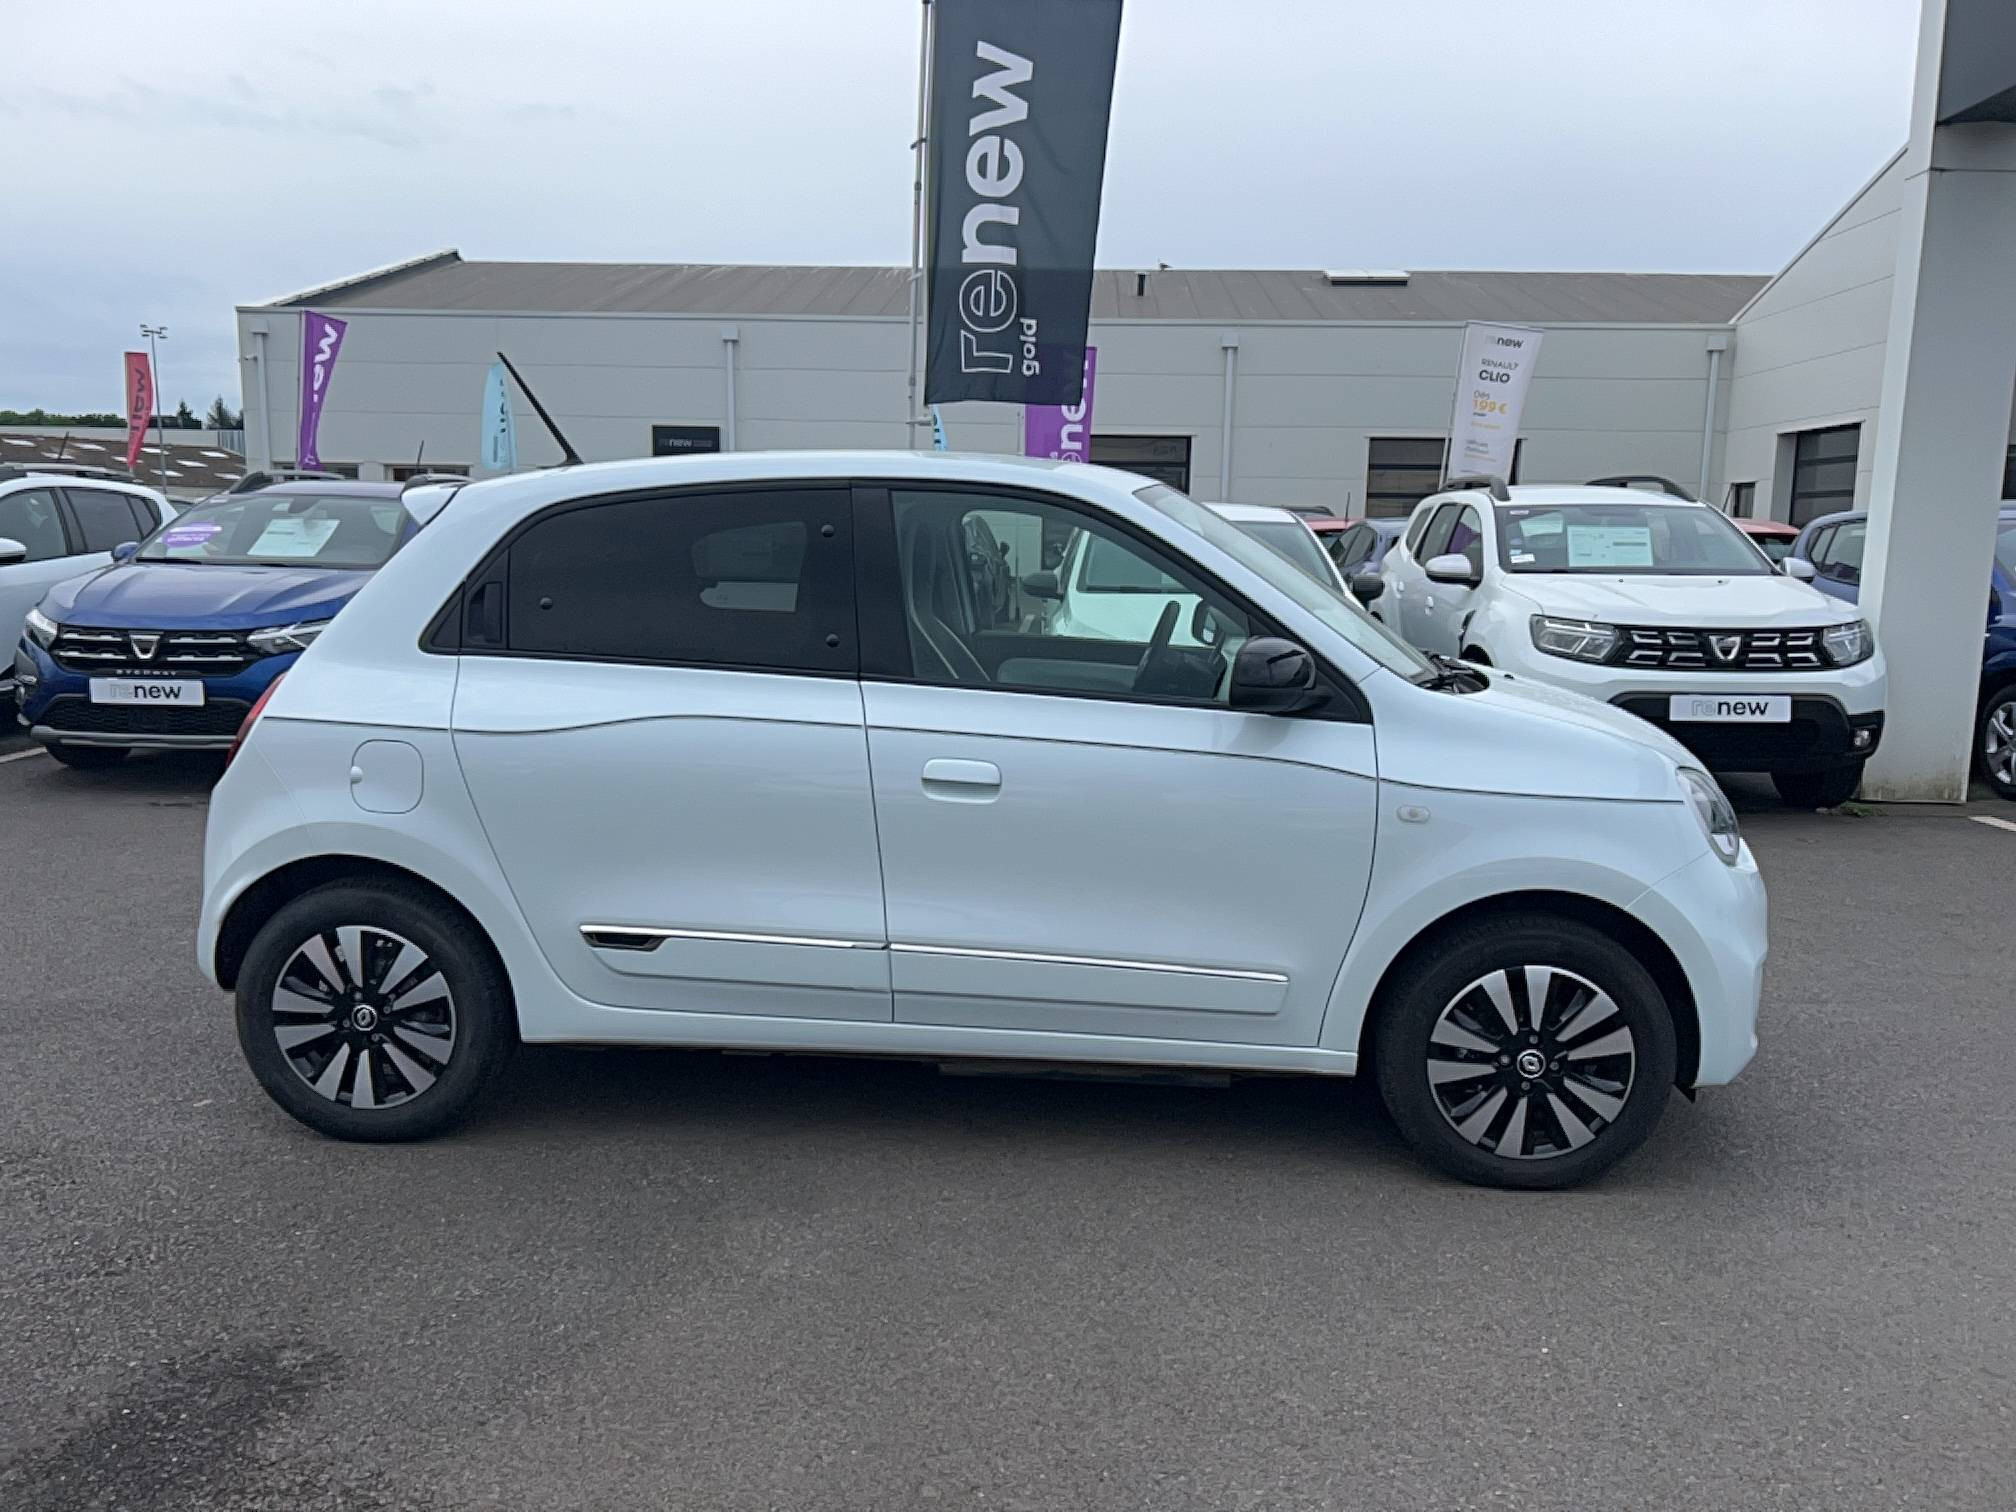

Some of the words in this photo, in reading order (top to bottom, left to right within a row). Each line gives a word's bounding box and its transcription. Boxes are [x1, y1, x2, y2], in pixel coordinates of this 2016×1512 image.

[959, 40, 1034, 374] renew
[1020, 318, 1040, 377] gold
[1481, 358, 1519, 370] RENAULT
[1479, 369, 1511, 383] CLIO
[1473, 399, 1497, 413] 199
[1691, 700, 1769, 716] renew
